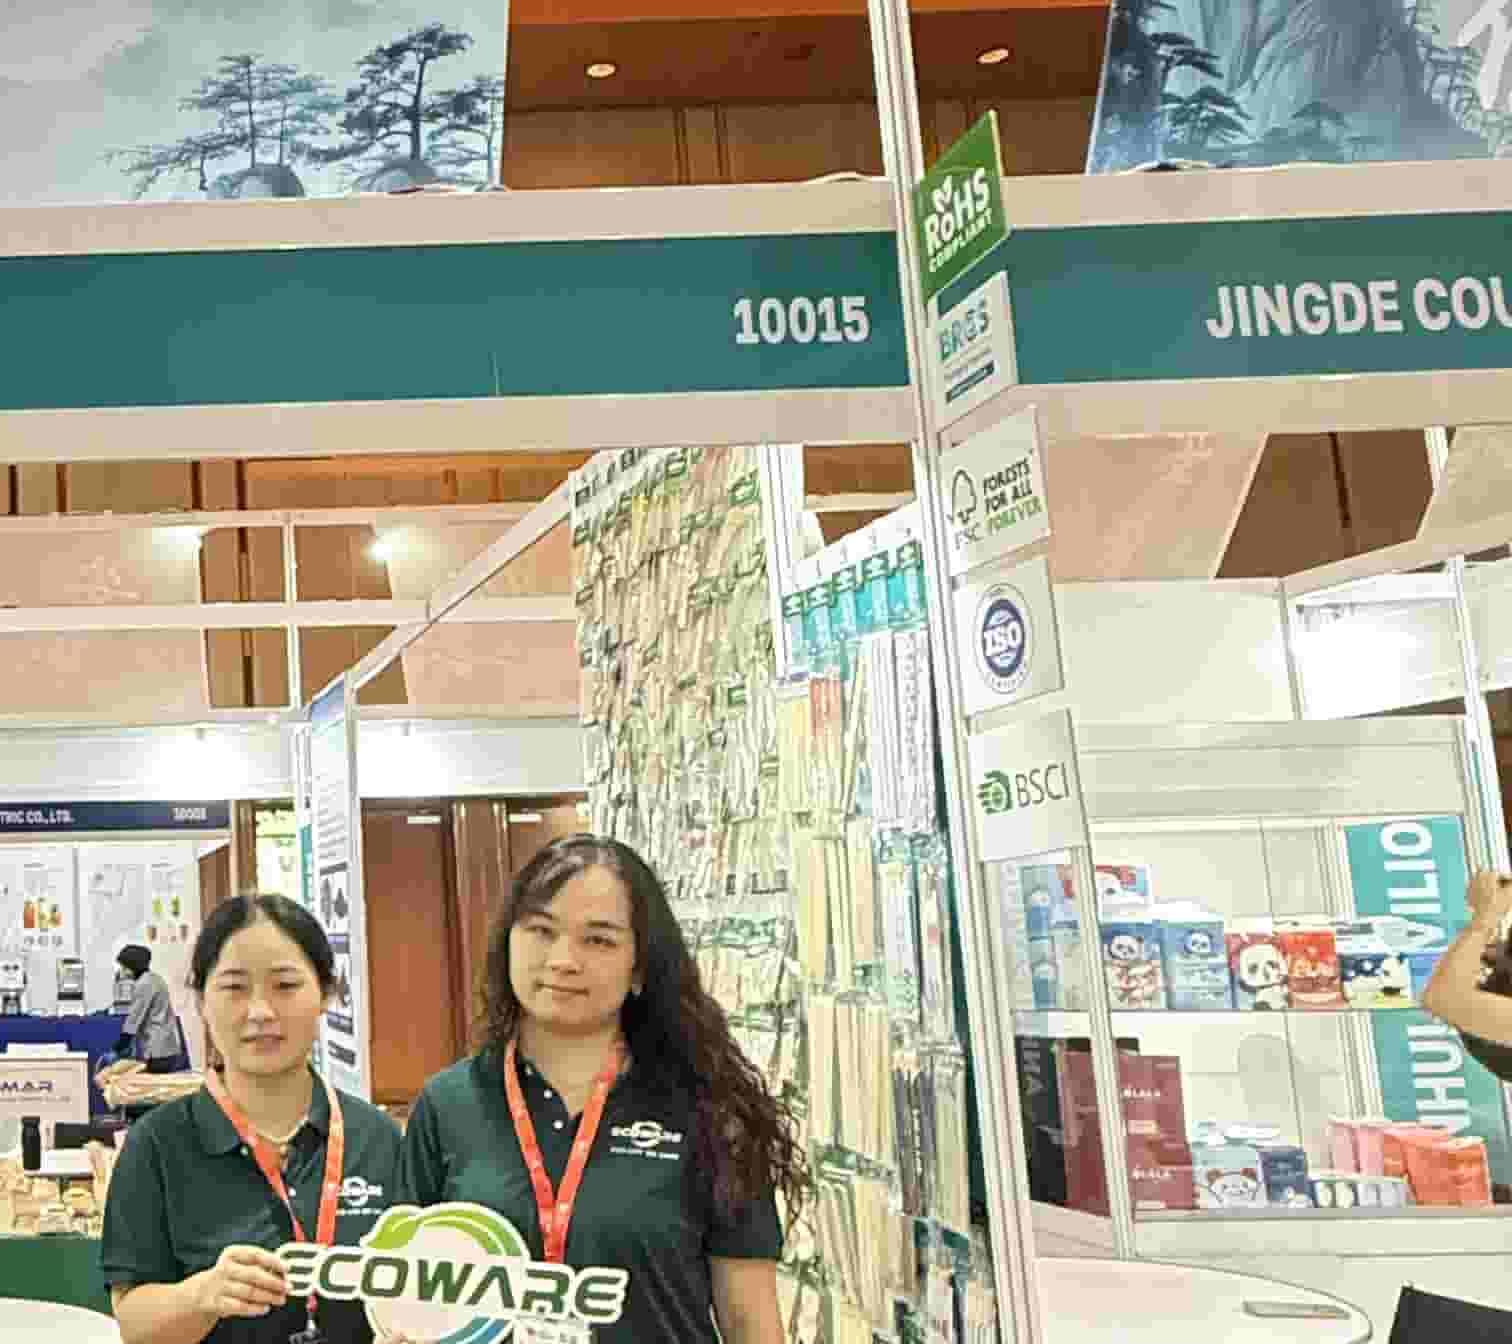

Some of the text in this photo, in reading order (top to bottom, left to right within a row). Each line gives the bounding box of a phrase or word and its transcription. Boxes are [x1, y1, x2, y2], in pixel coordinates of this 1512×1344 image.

[733, 295, 871, 344] 10015
[1206, 281, 1403, 340] JINGDE
[984, 620, 1022, 657] ISO
[1014, 761, 1069, 808] BSCI
[283, 1248, 629, 1317] ECOWARE
